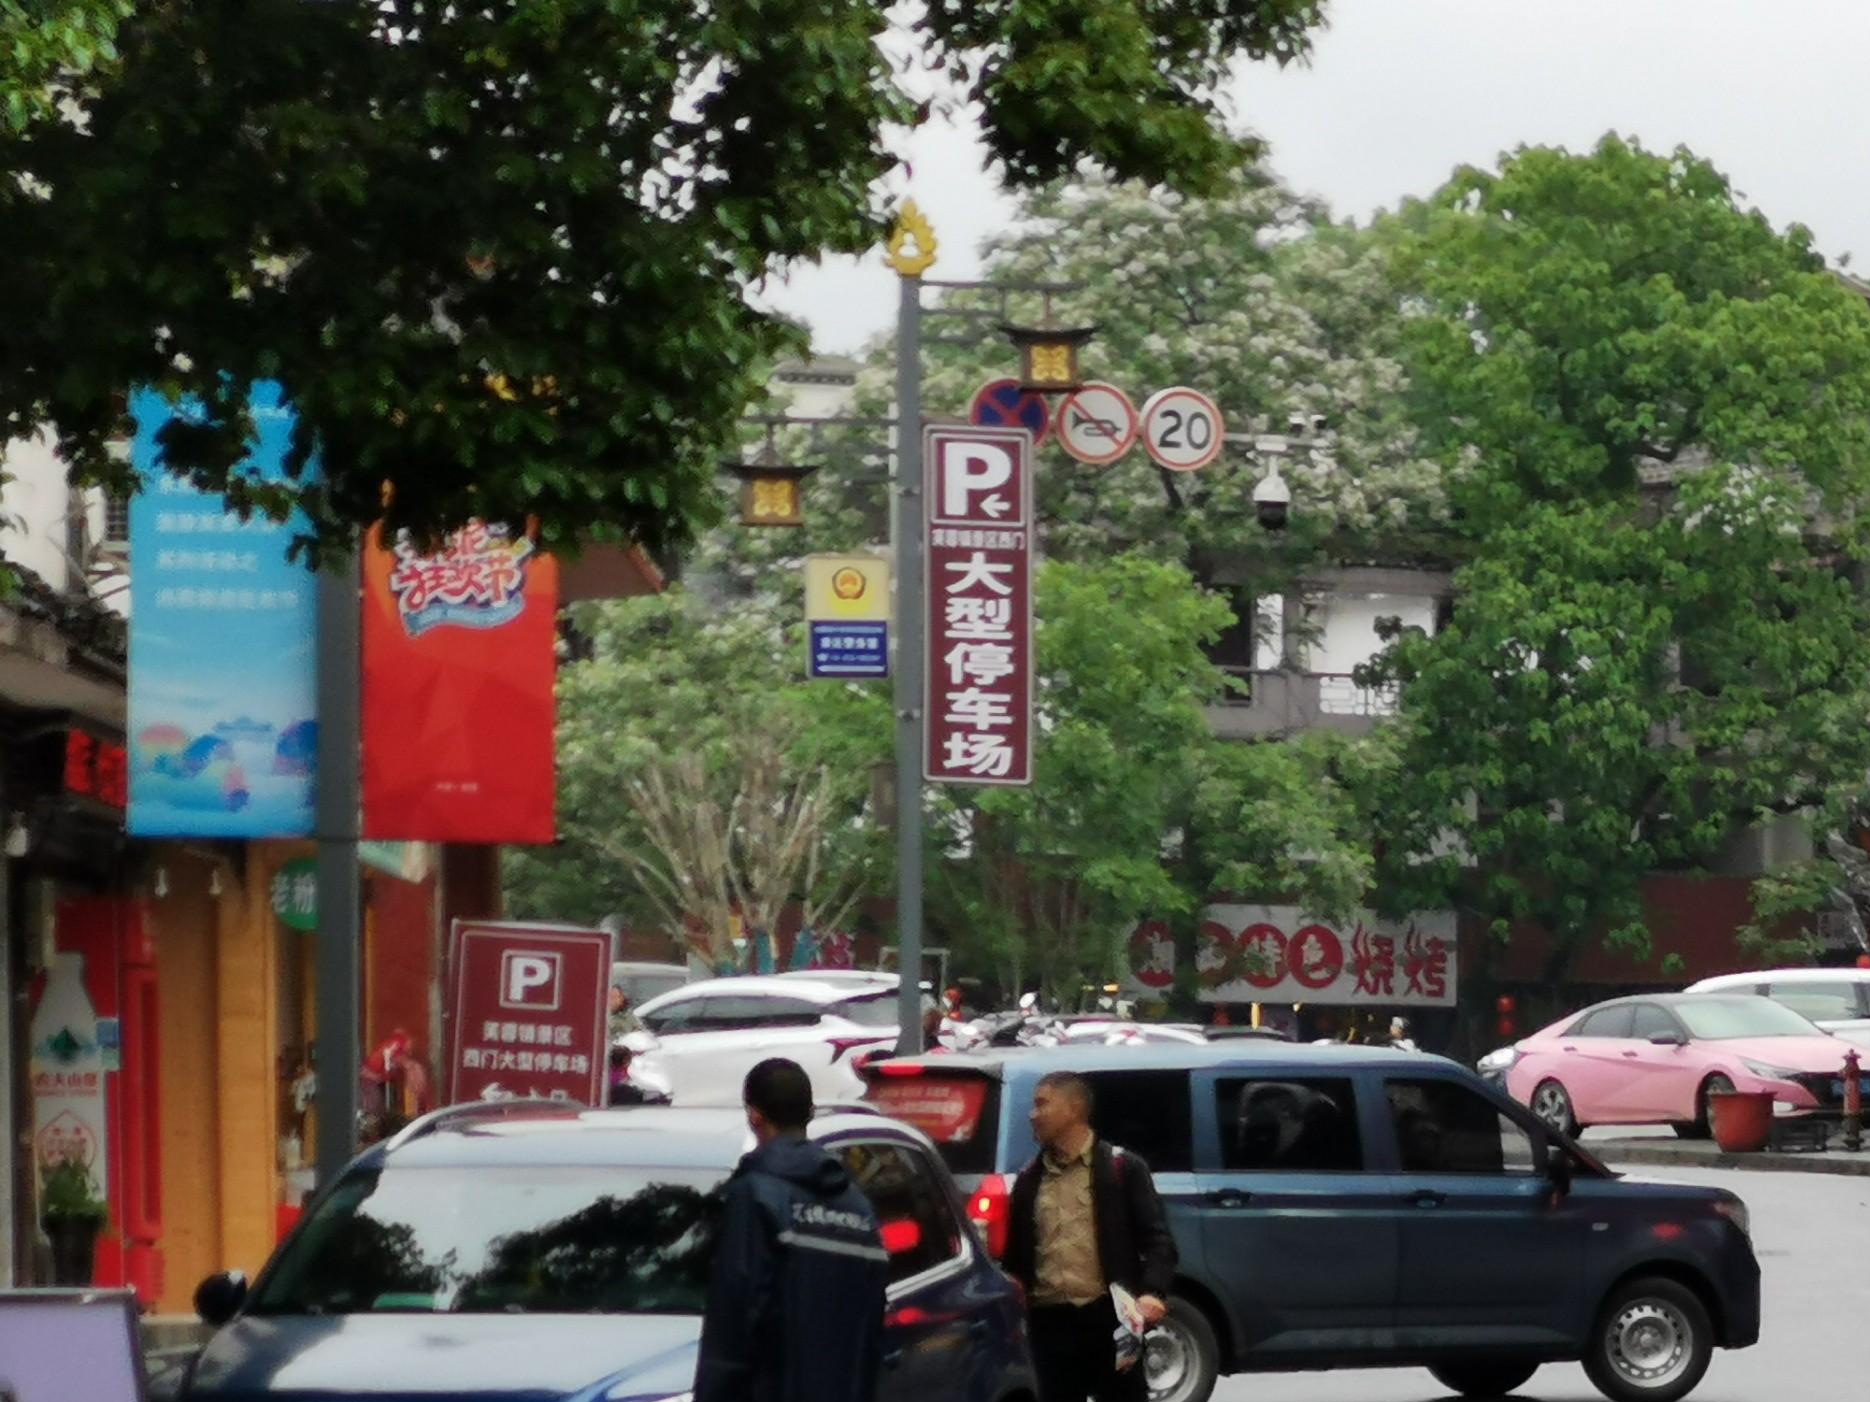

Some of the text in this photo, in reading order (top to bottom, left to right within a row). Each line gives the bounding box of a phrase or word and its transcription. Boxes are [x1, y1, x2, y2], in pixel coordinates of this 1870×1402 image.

[1158, 409, 1210, 449] 20
[944, 443, 1012, 515] P
[943, 551, 1013, 776] 大型停车场
[510, 957, 550, 1001] P
